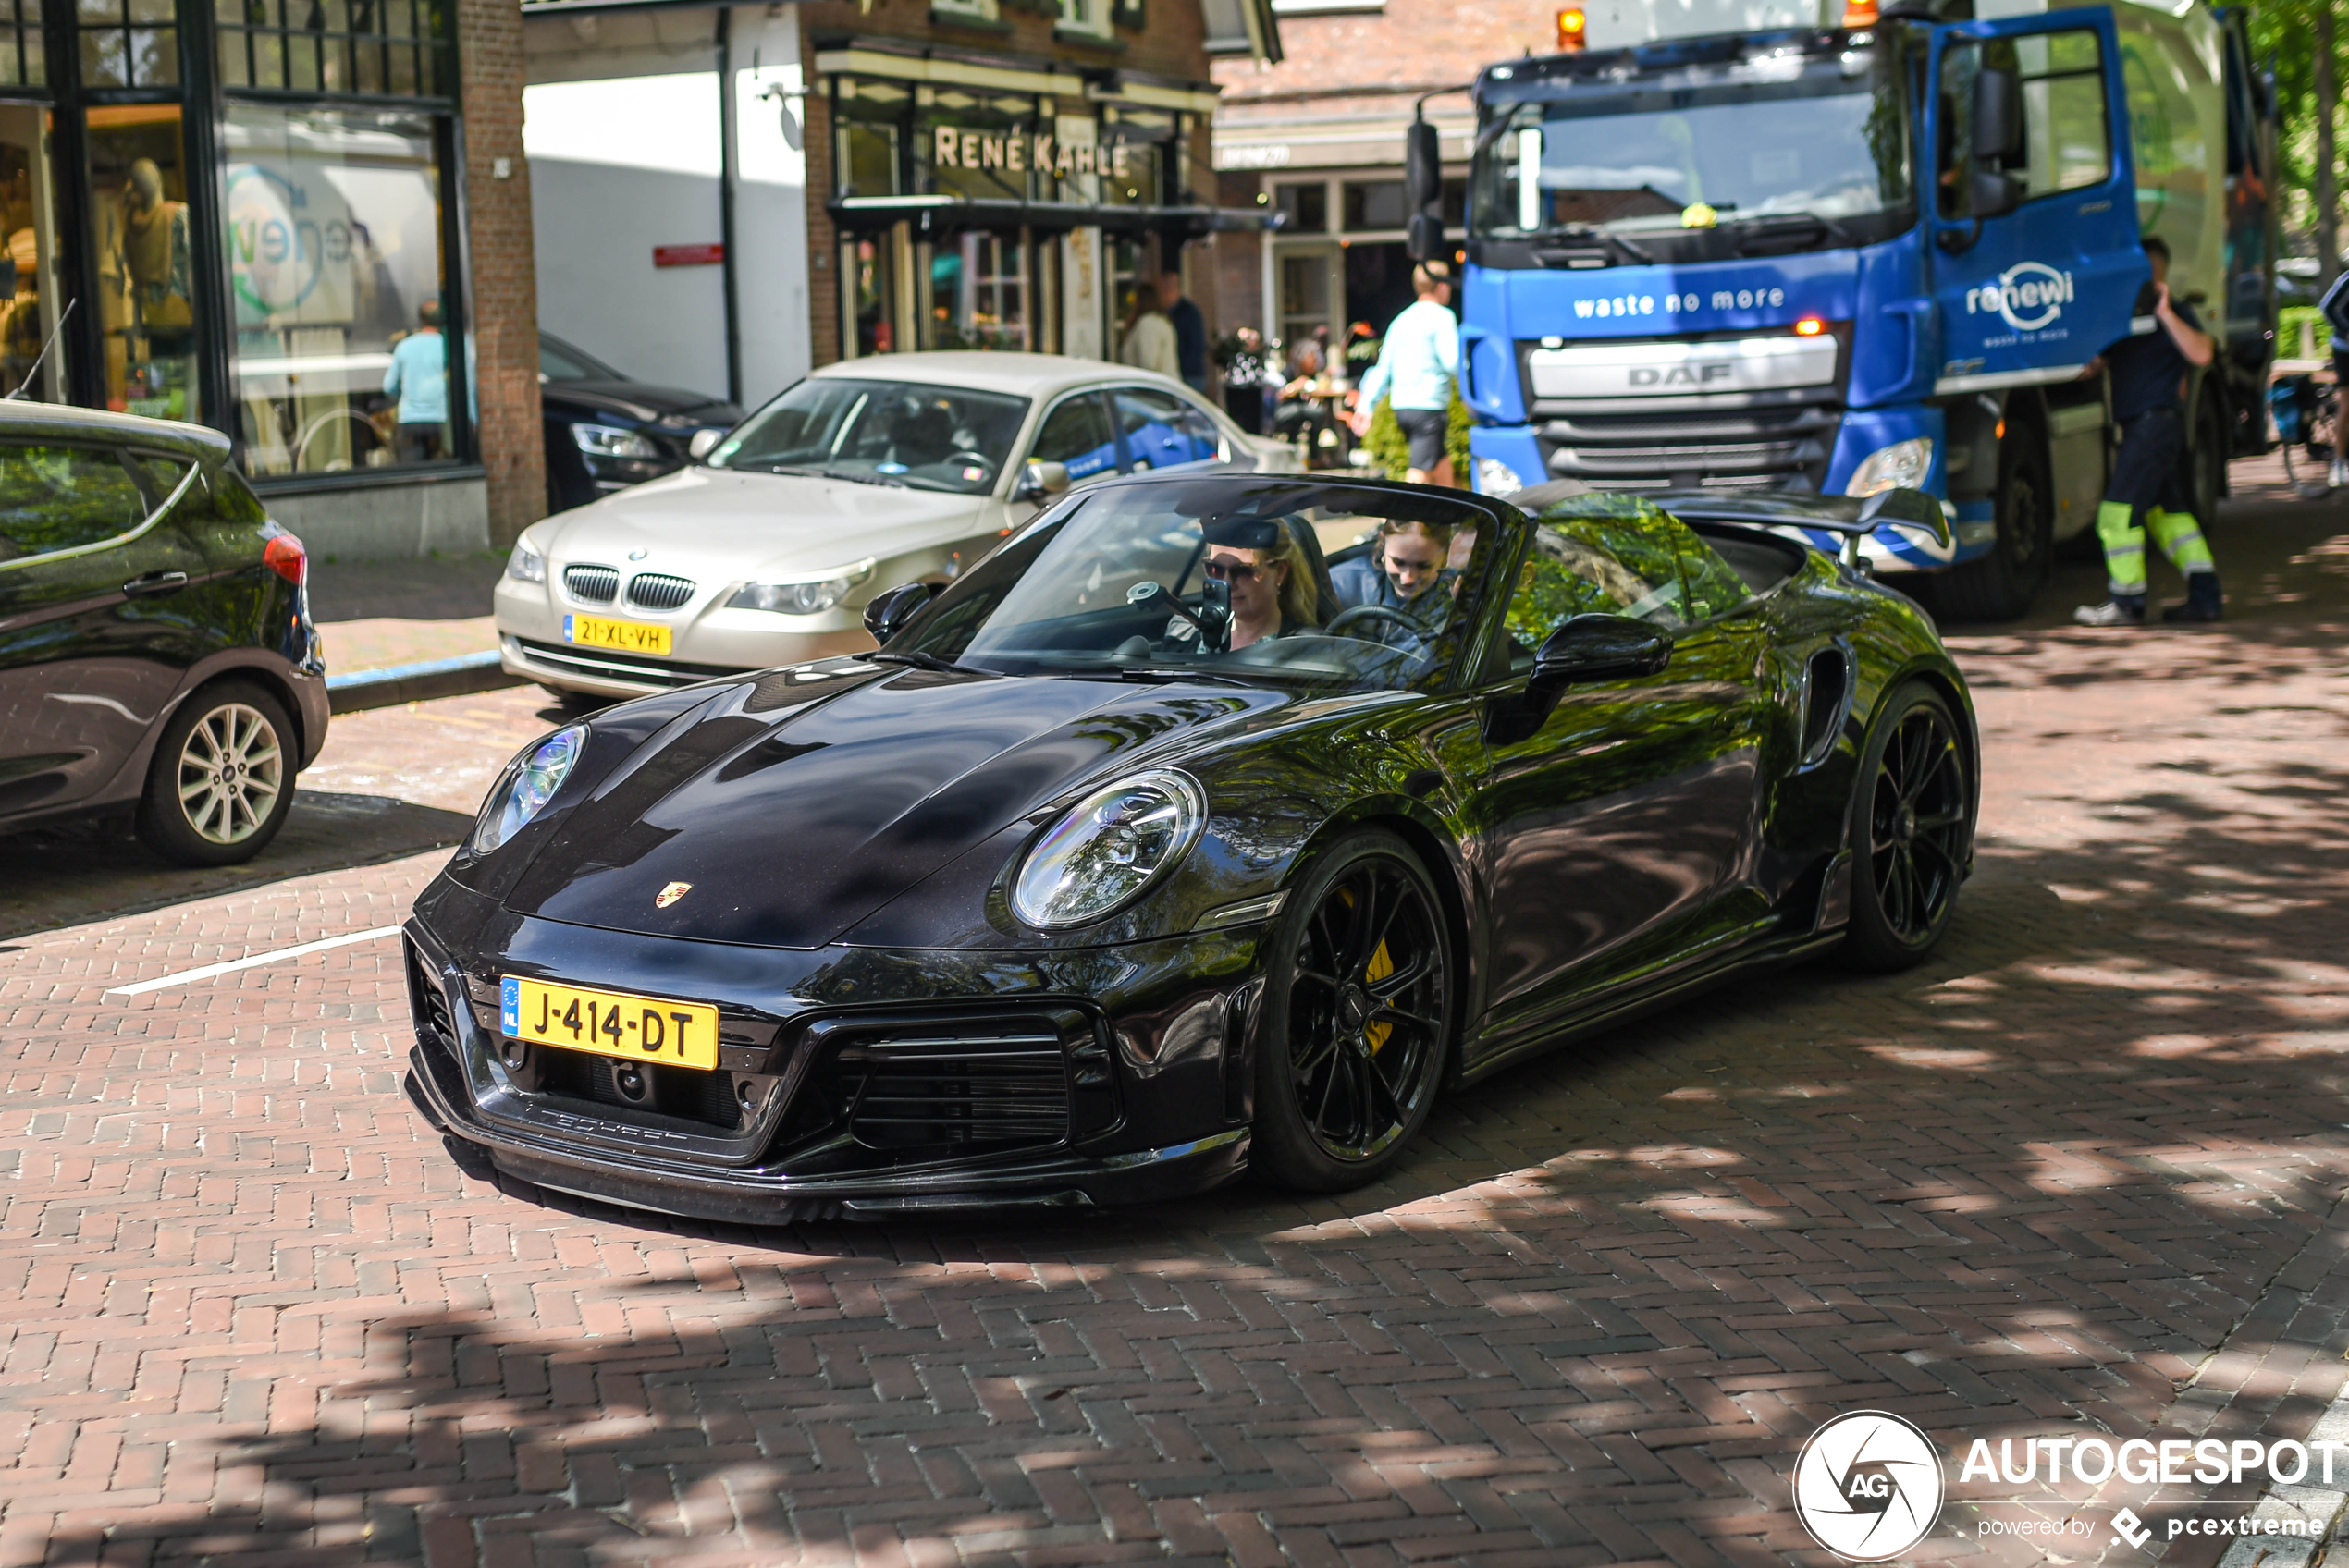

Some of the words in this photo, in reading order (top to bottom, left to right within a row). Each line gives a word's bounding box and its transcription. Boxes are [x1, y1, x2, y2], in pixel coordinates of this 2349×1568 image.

[1574, 294, 1654, 318] waste
[1666, 293, 1700, 312] no
[1712, 288, 1785, 310] more
[1966, 271, 2074, 314] renewi
[1629, 364, 1730, 386] DAF
[583, 621, 659, 648] 21-XL-VH
[504, 1012, 517, 1027] NL
[535, 993, 692, 1057] J-414-DT
